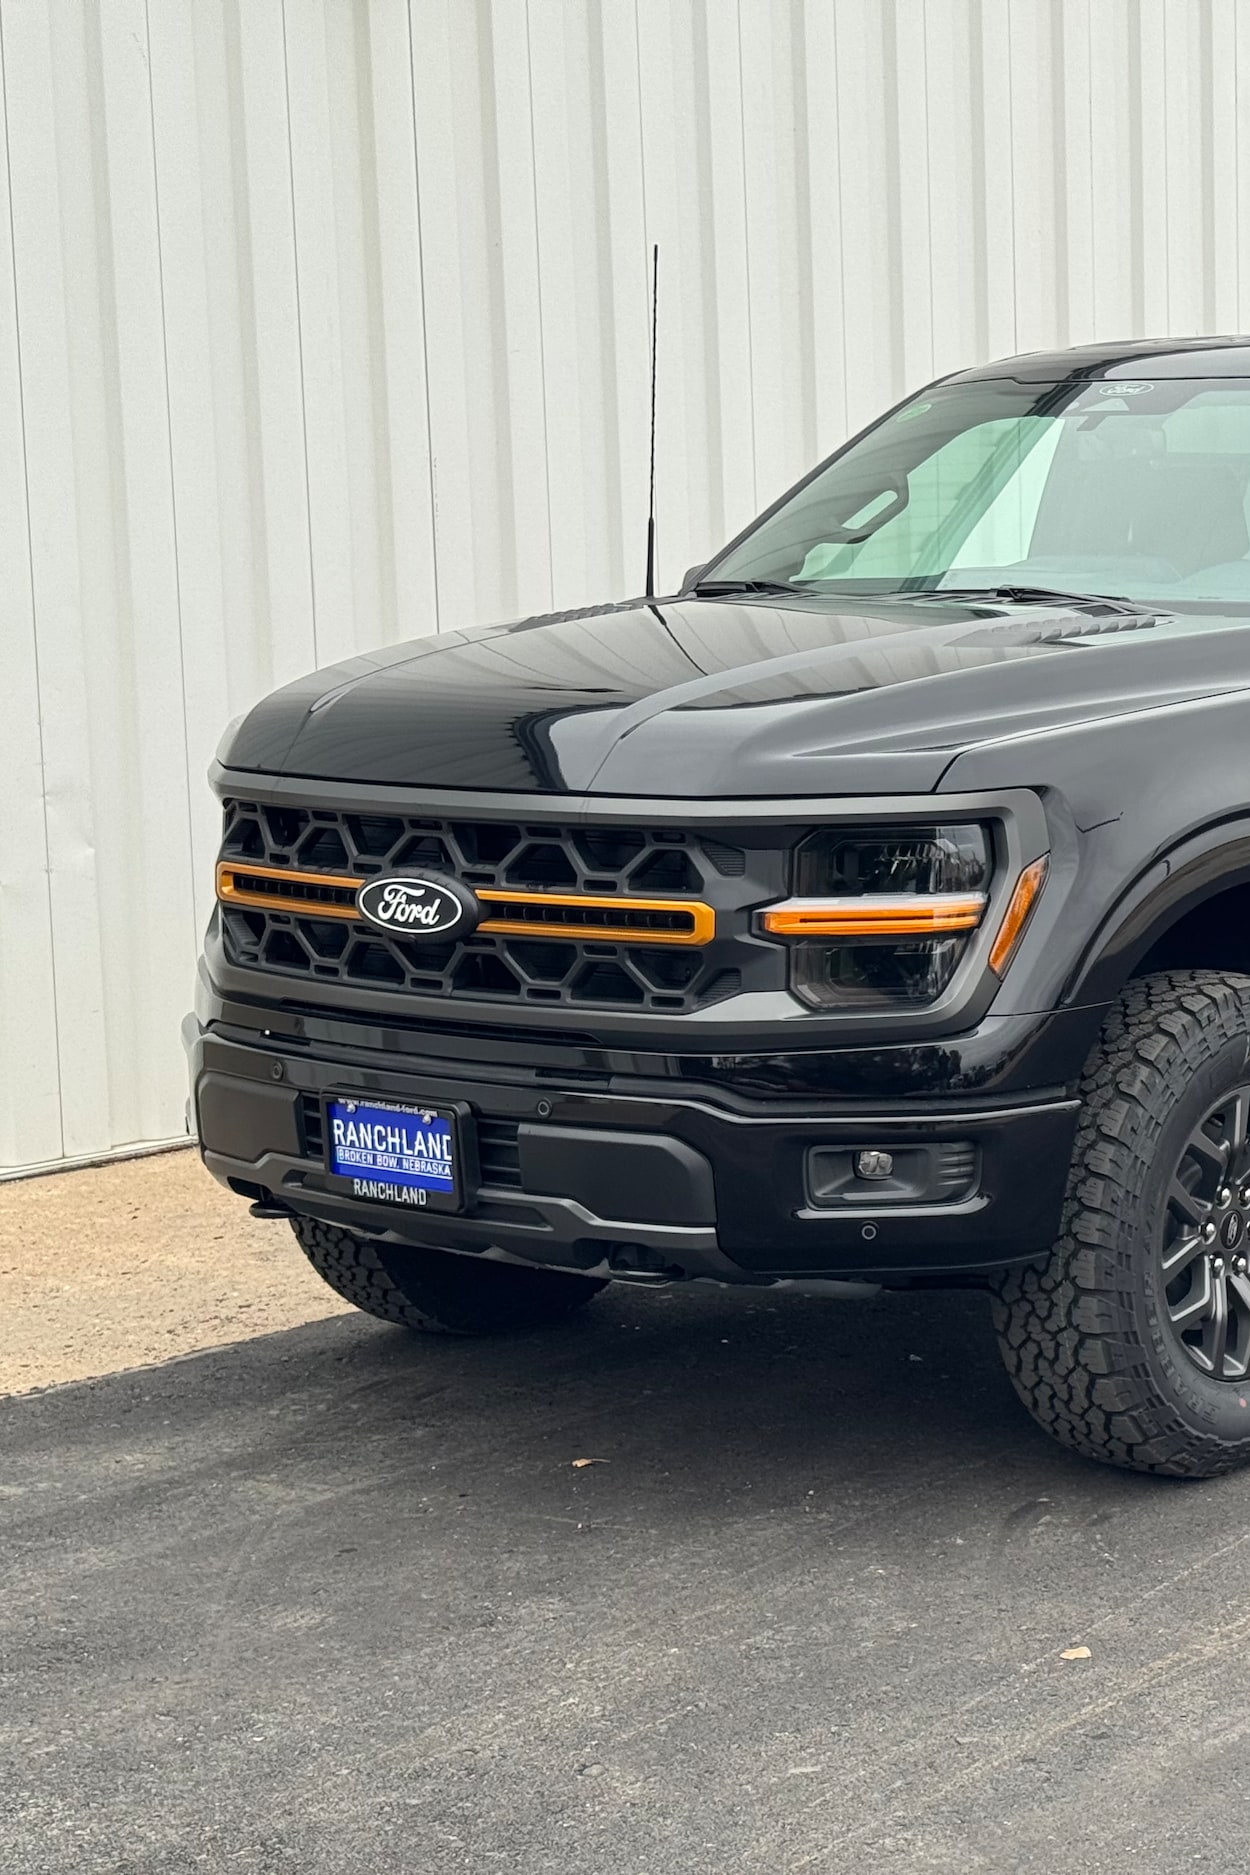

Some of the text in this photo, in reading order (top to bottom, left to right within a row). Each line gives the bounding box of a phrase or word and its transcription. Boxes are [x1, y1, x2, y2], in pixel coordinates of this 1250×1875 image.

[377, 884, 442, 926] Ford
[338, 1148, 374, 1165] BROKEN
[402, 1157, 451, 1176] NEBRASKA
[353, 1178, 427, 1206] RANCHLAND
